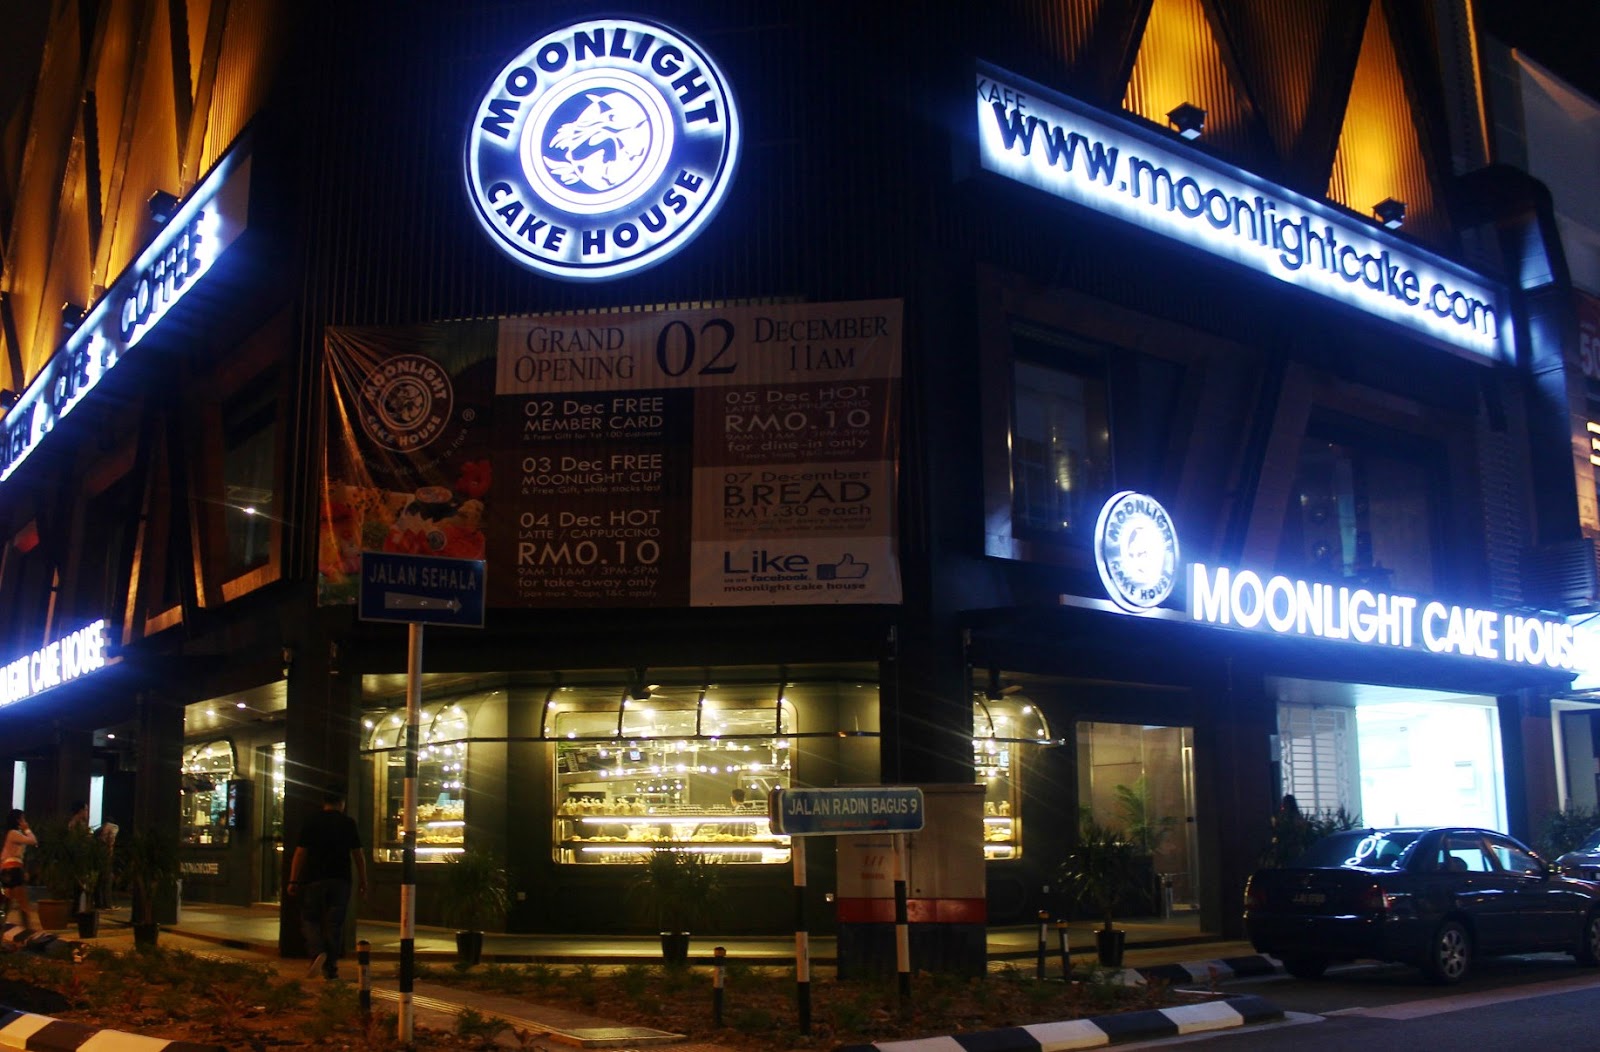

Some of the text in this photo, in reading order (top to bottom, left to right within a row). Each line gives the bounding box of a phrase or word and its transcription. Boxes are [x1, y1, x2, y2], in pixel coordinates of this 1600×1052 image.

[480, 27, 718, 140] MOONLIGHT
[487, 170, 704, 256] CAKE HOUSE
[993, 101, 1500, 340] www.moonlightcake.com
[527, 326, 625, 354] GRAND
[754, 316, 889, 343] DECEMBER
[656, 318, 738, 377] 02
[790, 345, 856, 371] 11AM
[365, 360, 447, 401] MOONLIGHT
[514, 355, 635, 383] OPENING
[525, 397, 663, 417] 02 Dec FREE
[726, 386, 871, 404] 05 Dec HOT
[366, 414, 442, 448] CAKE HOUSE
[524, 415, 663, 432] MEMBER CARD
[728, 438, 867, 453] for dine-in only
[522, 454, 662, 473] 03 Dec FREE
[521, 471, 662, 486] MOONLIGHT CUP
[724, 468, 871, 484] 07 December
[532, 487, 554, 495] Free
[584, 485, 607, 493] while
[611, 485, 640, 493] stocks
[724, 481, 871, 506] BREAD
[520, 509, 661, 528] 04 Dec HOT
[724, 503, 871, 519] RM1.30 each
[518, 530, 554, 539] LATTE
[570, 528, 661, 539] CAPPUCCINO
[724, 550, 809, 574] Like
[368, 563, 477, 591] JALAN SEHALA
[518, 576, 657, 589] for take-away only
[724, 582, 866, 593] moonlight cake house
[1191, 563, 1417, 649] MOONLIGHT
[1421, 601, 1499, 661] CAKE
[62, 619, 105, 681] HOUSE
[788, 797, 918, 816] JALAN RADIN BAGUS 9
